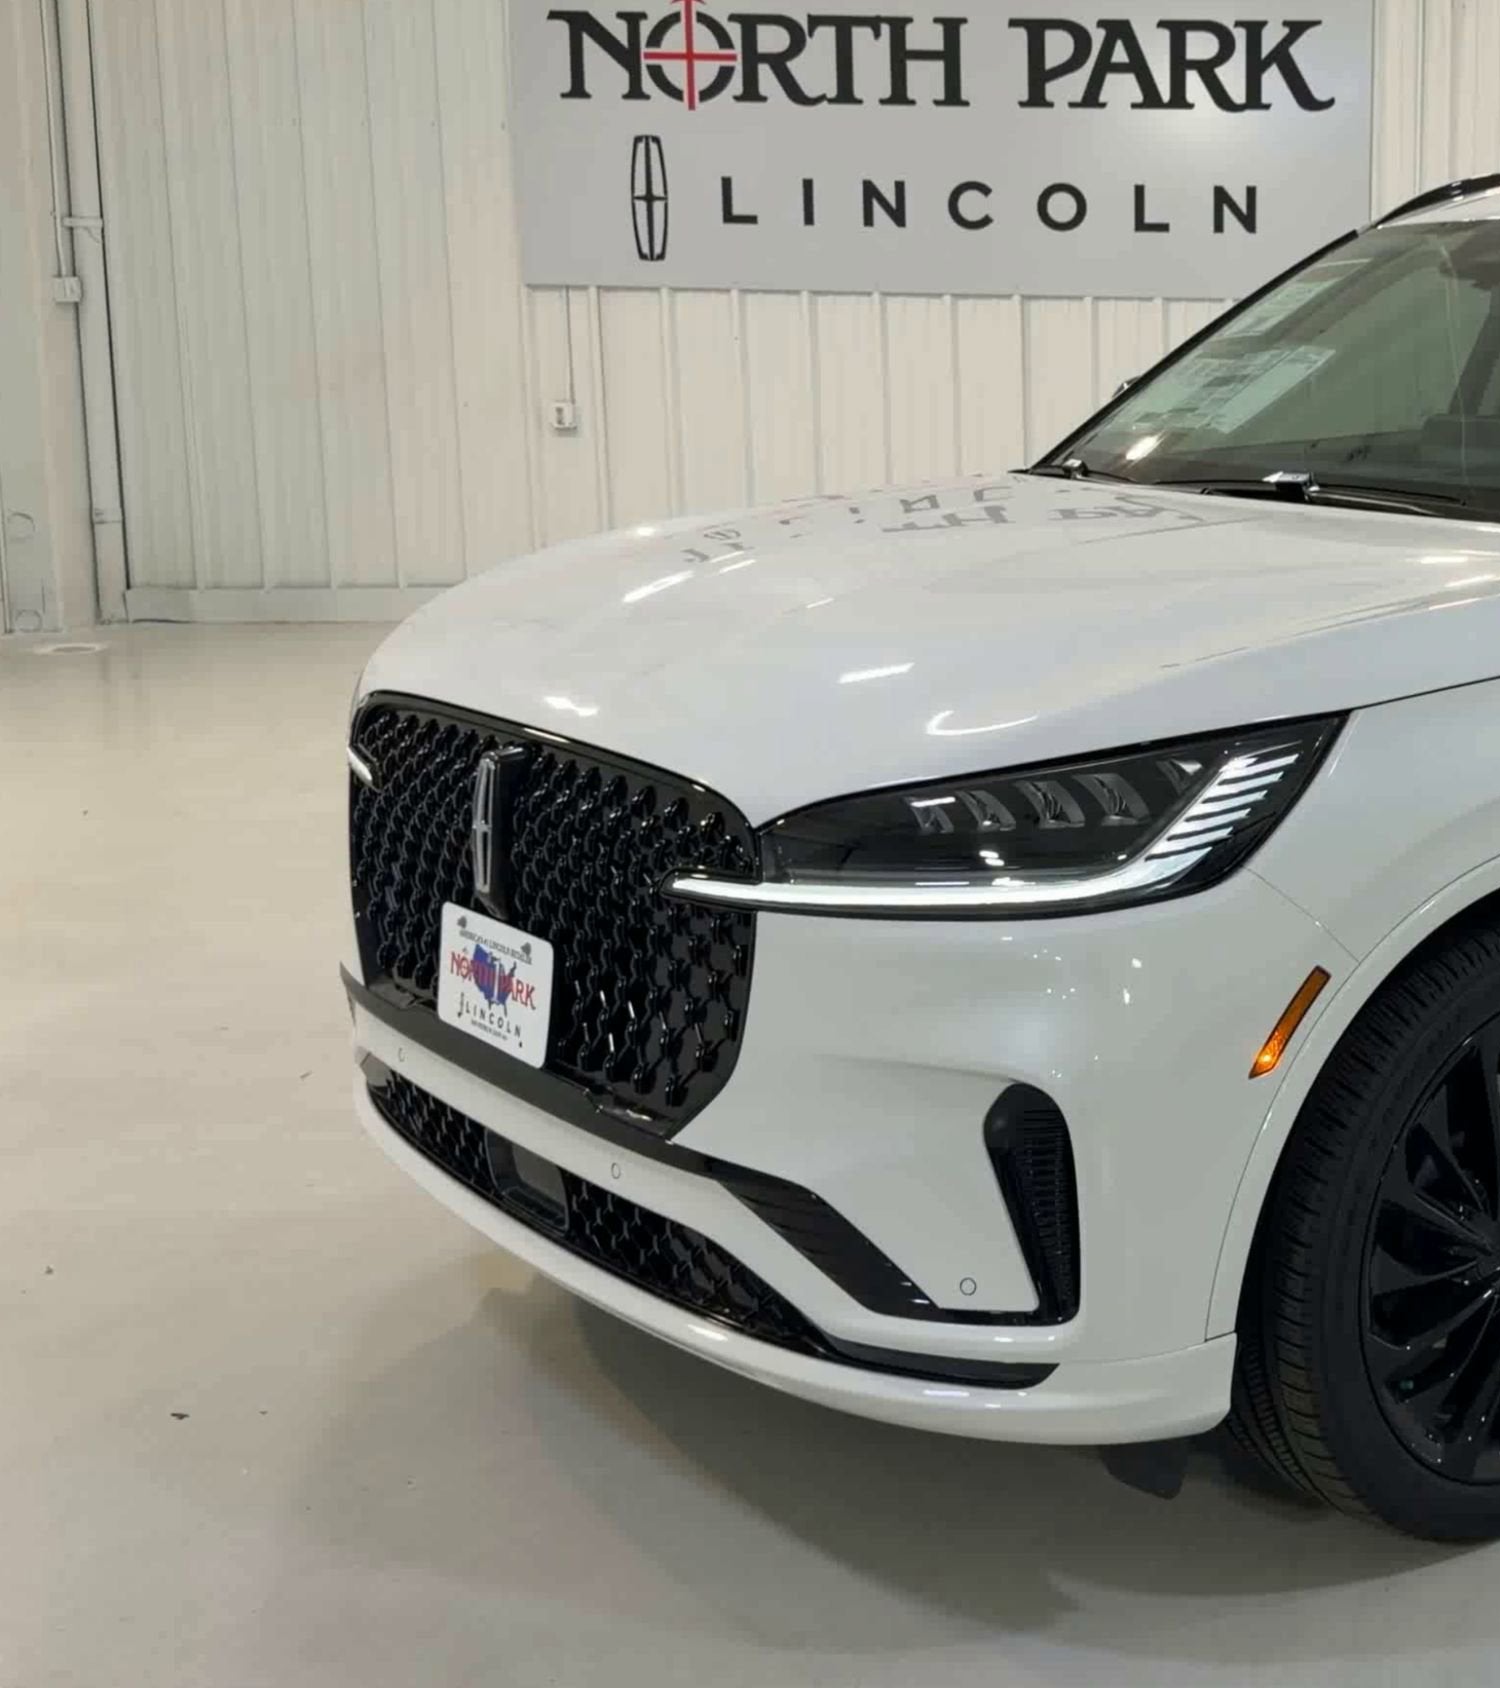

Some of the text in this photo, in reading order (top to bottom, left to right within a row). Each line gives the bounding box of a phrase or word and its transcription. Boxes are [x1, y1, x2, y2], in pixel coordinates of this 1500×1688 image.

[546, 8, 1336, 112] NORTH PARK
[721, 176, 1257, 234] LINCOLN
[499, 971, 537, 1011] PARK
[465, 1000, 521, 1038] LINCOLN
